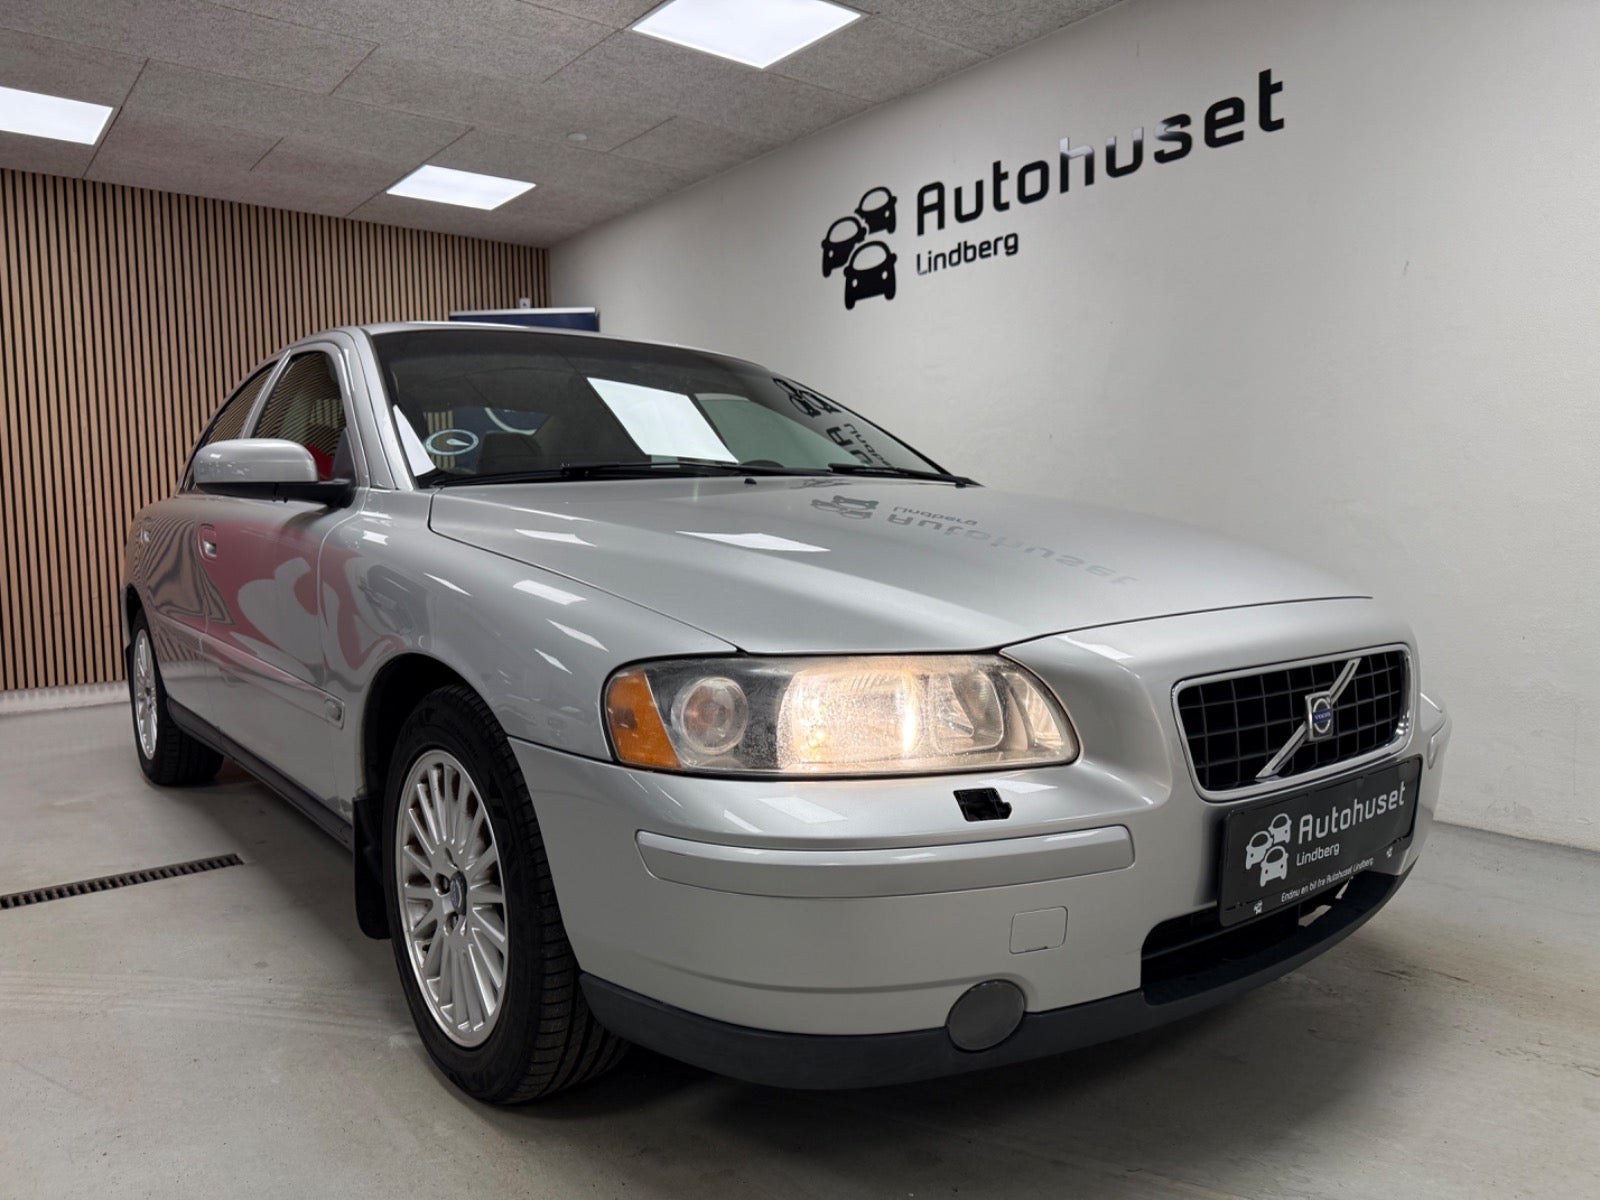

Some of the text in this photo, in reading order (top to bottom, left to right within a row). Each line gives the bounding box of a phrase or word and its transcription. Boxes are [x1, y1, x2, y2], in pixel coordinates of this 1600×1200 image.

[916, 68, 1285, 236] Autohuset
[916, 232, 1019, 276] Lindberg
[1298, 781, 1406, 844] Autohuset
[1296, 843, 1340, 866] Lindberg
[1301, 885, 1309, 895] en
